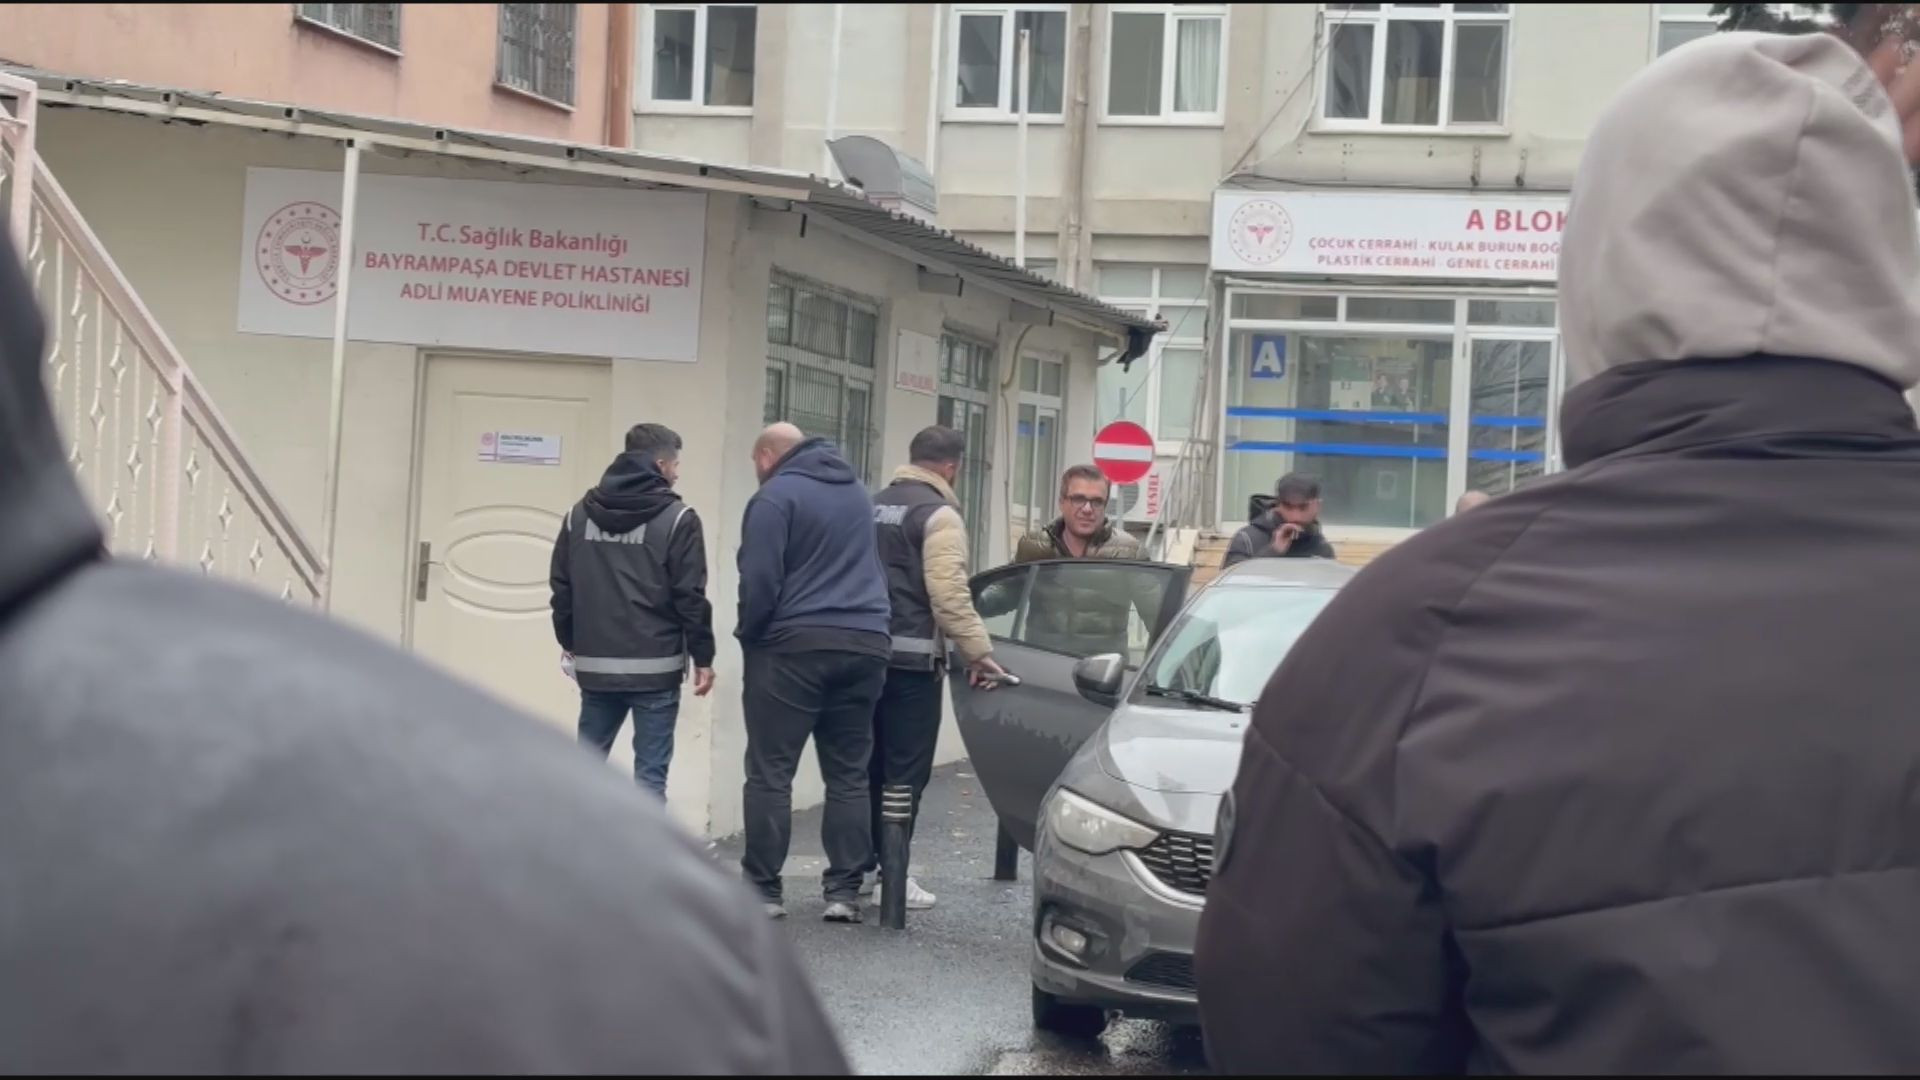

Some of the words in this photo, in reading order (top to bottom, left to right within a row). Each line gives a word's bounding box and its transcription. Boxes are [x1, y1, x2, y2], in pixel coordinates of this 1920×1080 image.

[1467, 209, 1485, 230] A
[418, 223, 457, 244] T.C.
[459, 227, 525, 251] Sağlık
[528, 229, 629, 255] Bakanlığı
[1309, 238, 1356, 250] ÇOCUK
[1358, 238, 1417, 251] CERRAHİ
[1428, 241, 1475, 252] KULAK
[1477, 241, 1528, 253] BURUN
[364, 251, 499, 278] BAYRAMPAŞA
[503, 259, 578, 281] DEVLET
[580, 264, 690, 288] HASTANESİ
[1317, 254, 1375, 266] PLASTİK
[1377, 255, 1436, 268] CERRAHİ
[1446, 258, 1490, 269] GENEL
[1494, 258, 1555, 271] CERRAHİ
[400, 283, 445, 300] ADLİ
[447, 285, 538, 307] MUAYENE
[541, 291, 651, 314] POLİKLİNİĞİ
[1253, 341, 1282, 373] A
[1147, 475, 1159, 514] VESTEL
